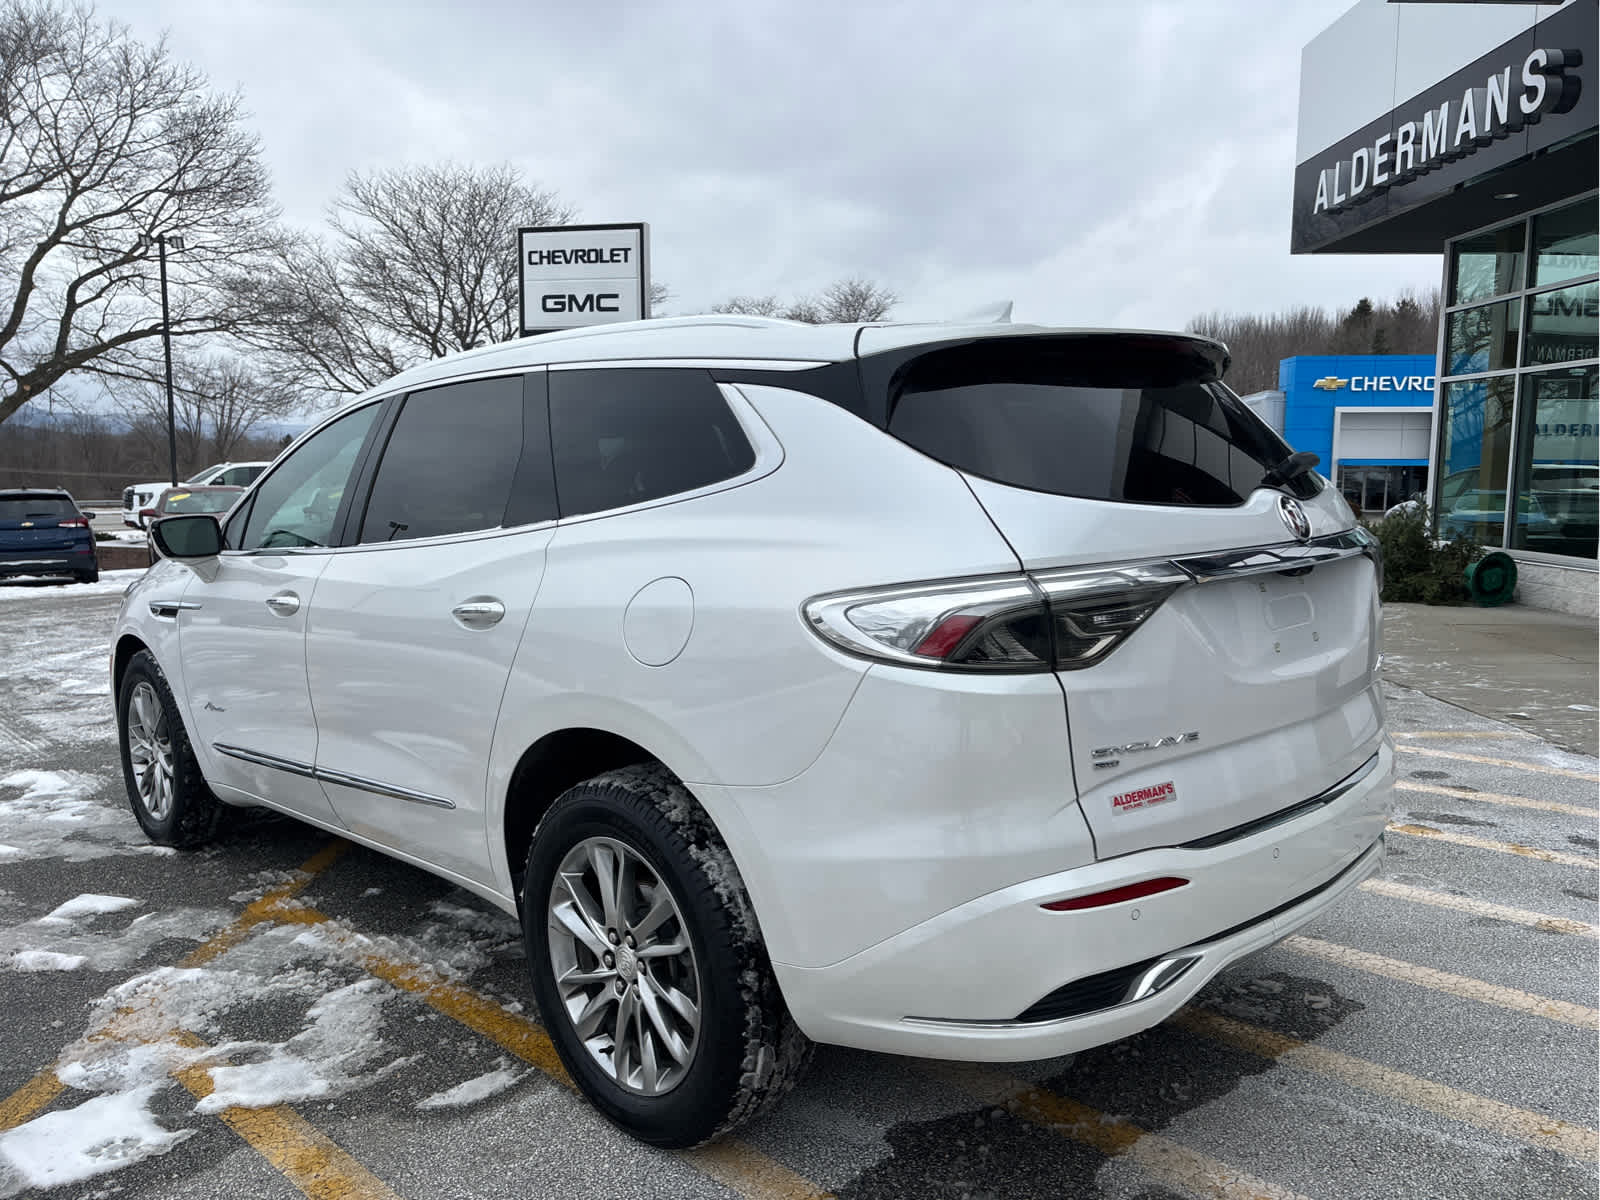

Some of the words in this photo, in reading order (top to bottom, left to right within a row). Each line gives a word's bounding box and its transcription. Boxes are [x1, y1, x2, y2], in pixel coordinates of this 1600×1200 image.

[1313, 49, 1547, 214] ALDERMANS
[528, 248, 631, 265] CHEVROLET
[542, 294, 619, 312] GMC
[1113, 783, 1174, 807] ALDERMAN'S
